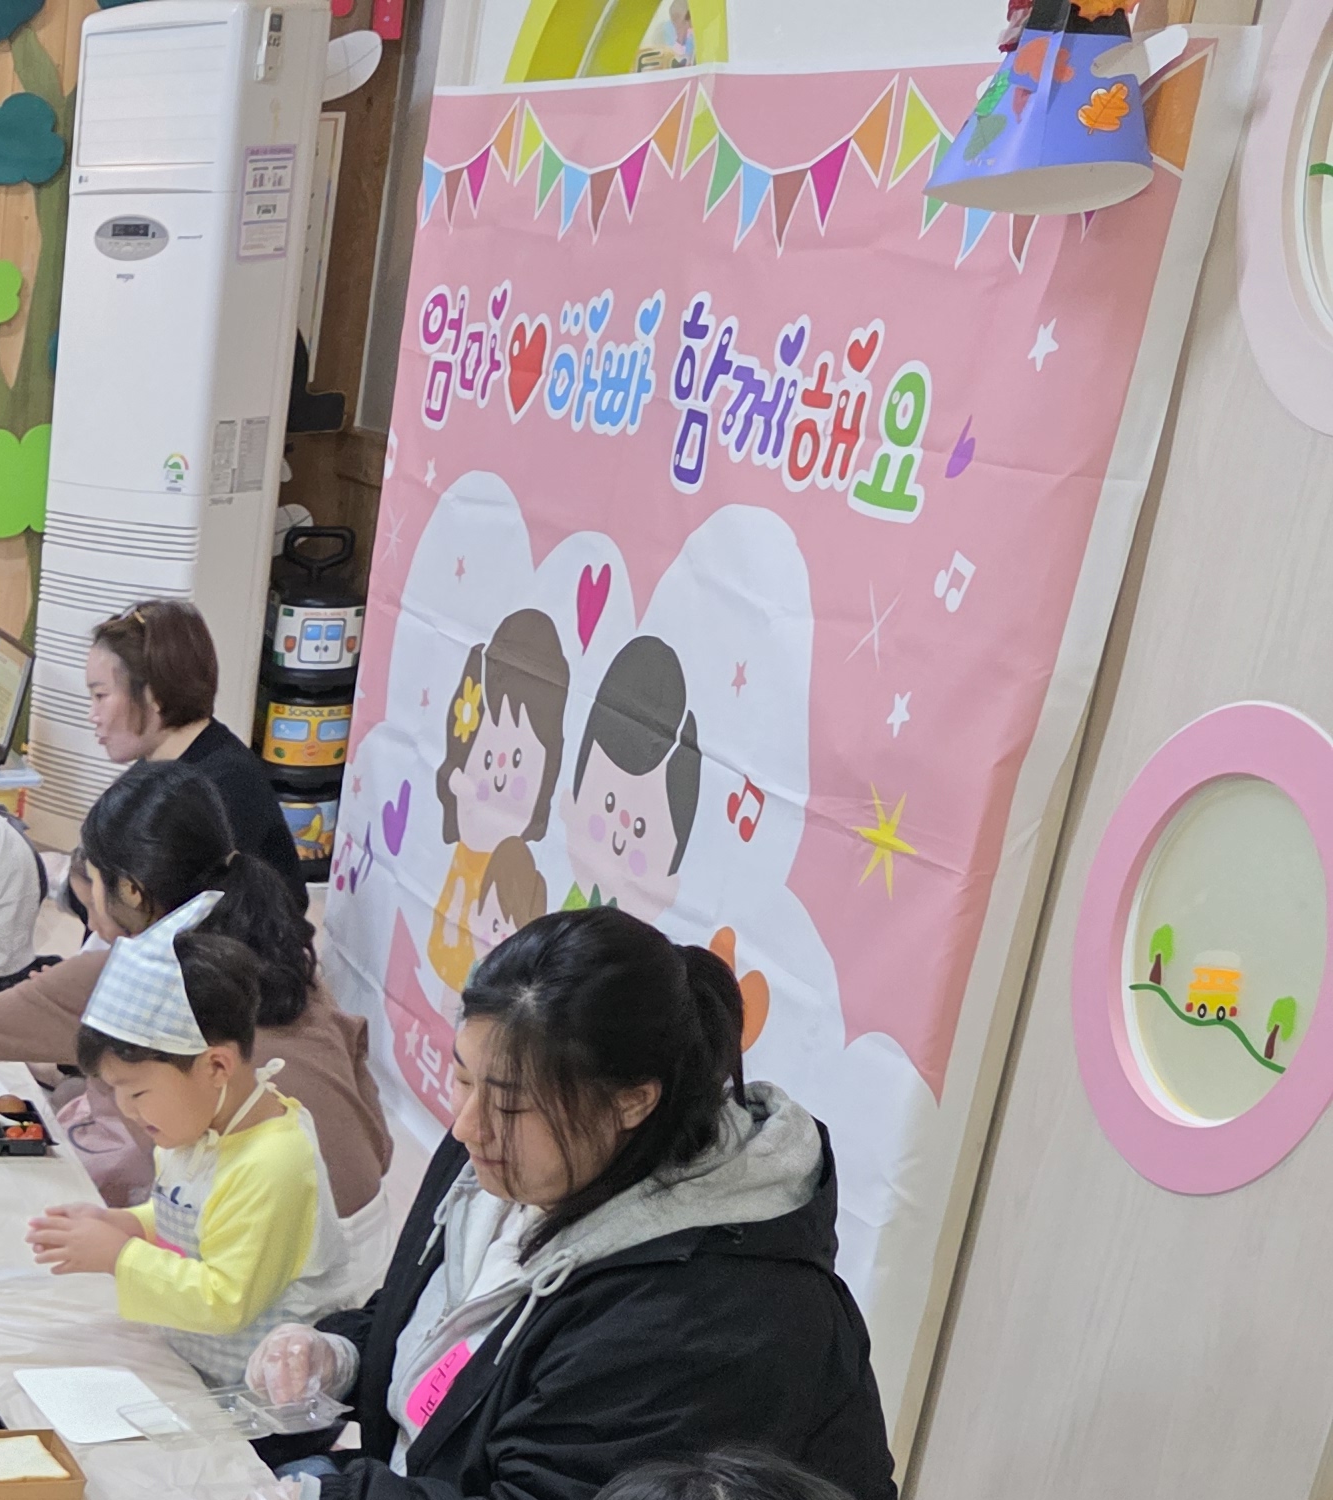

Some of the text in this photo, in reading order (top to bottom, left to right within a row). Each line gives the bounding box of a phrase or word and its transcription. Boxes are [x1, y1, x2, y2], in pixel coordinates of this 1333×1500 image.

[422, 286, 927, 513] 엄마 아빠 함께해요
